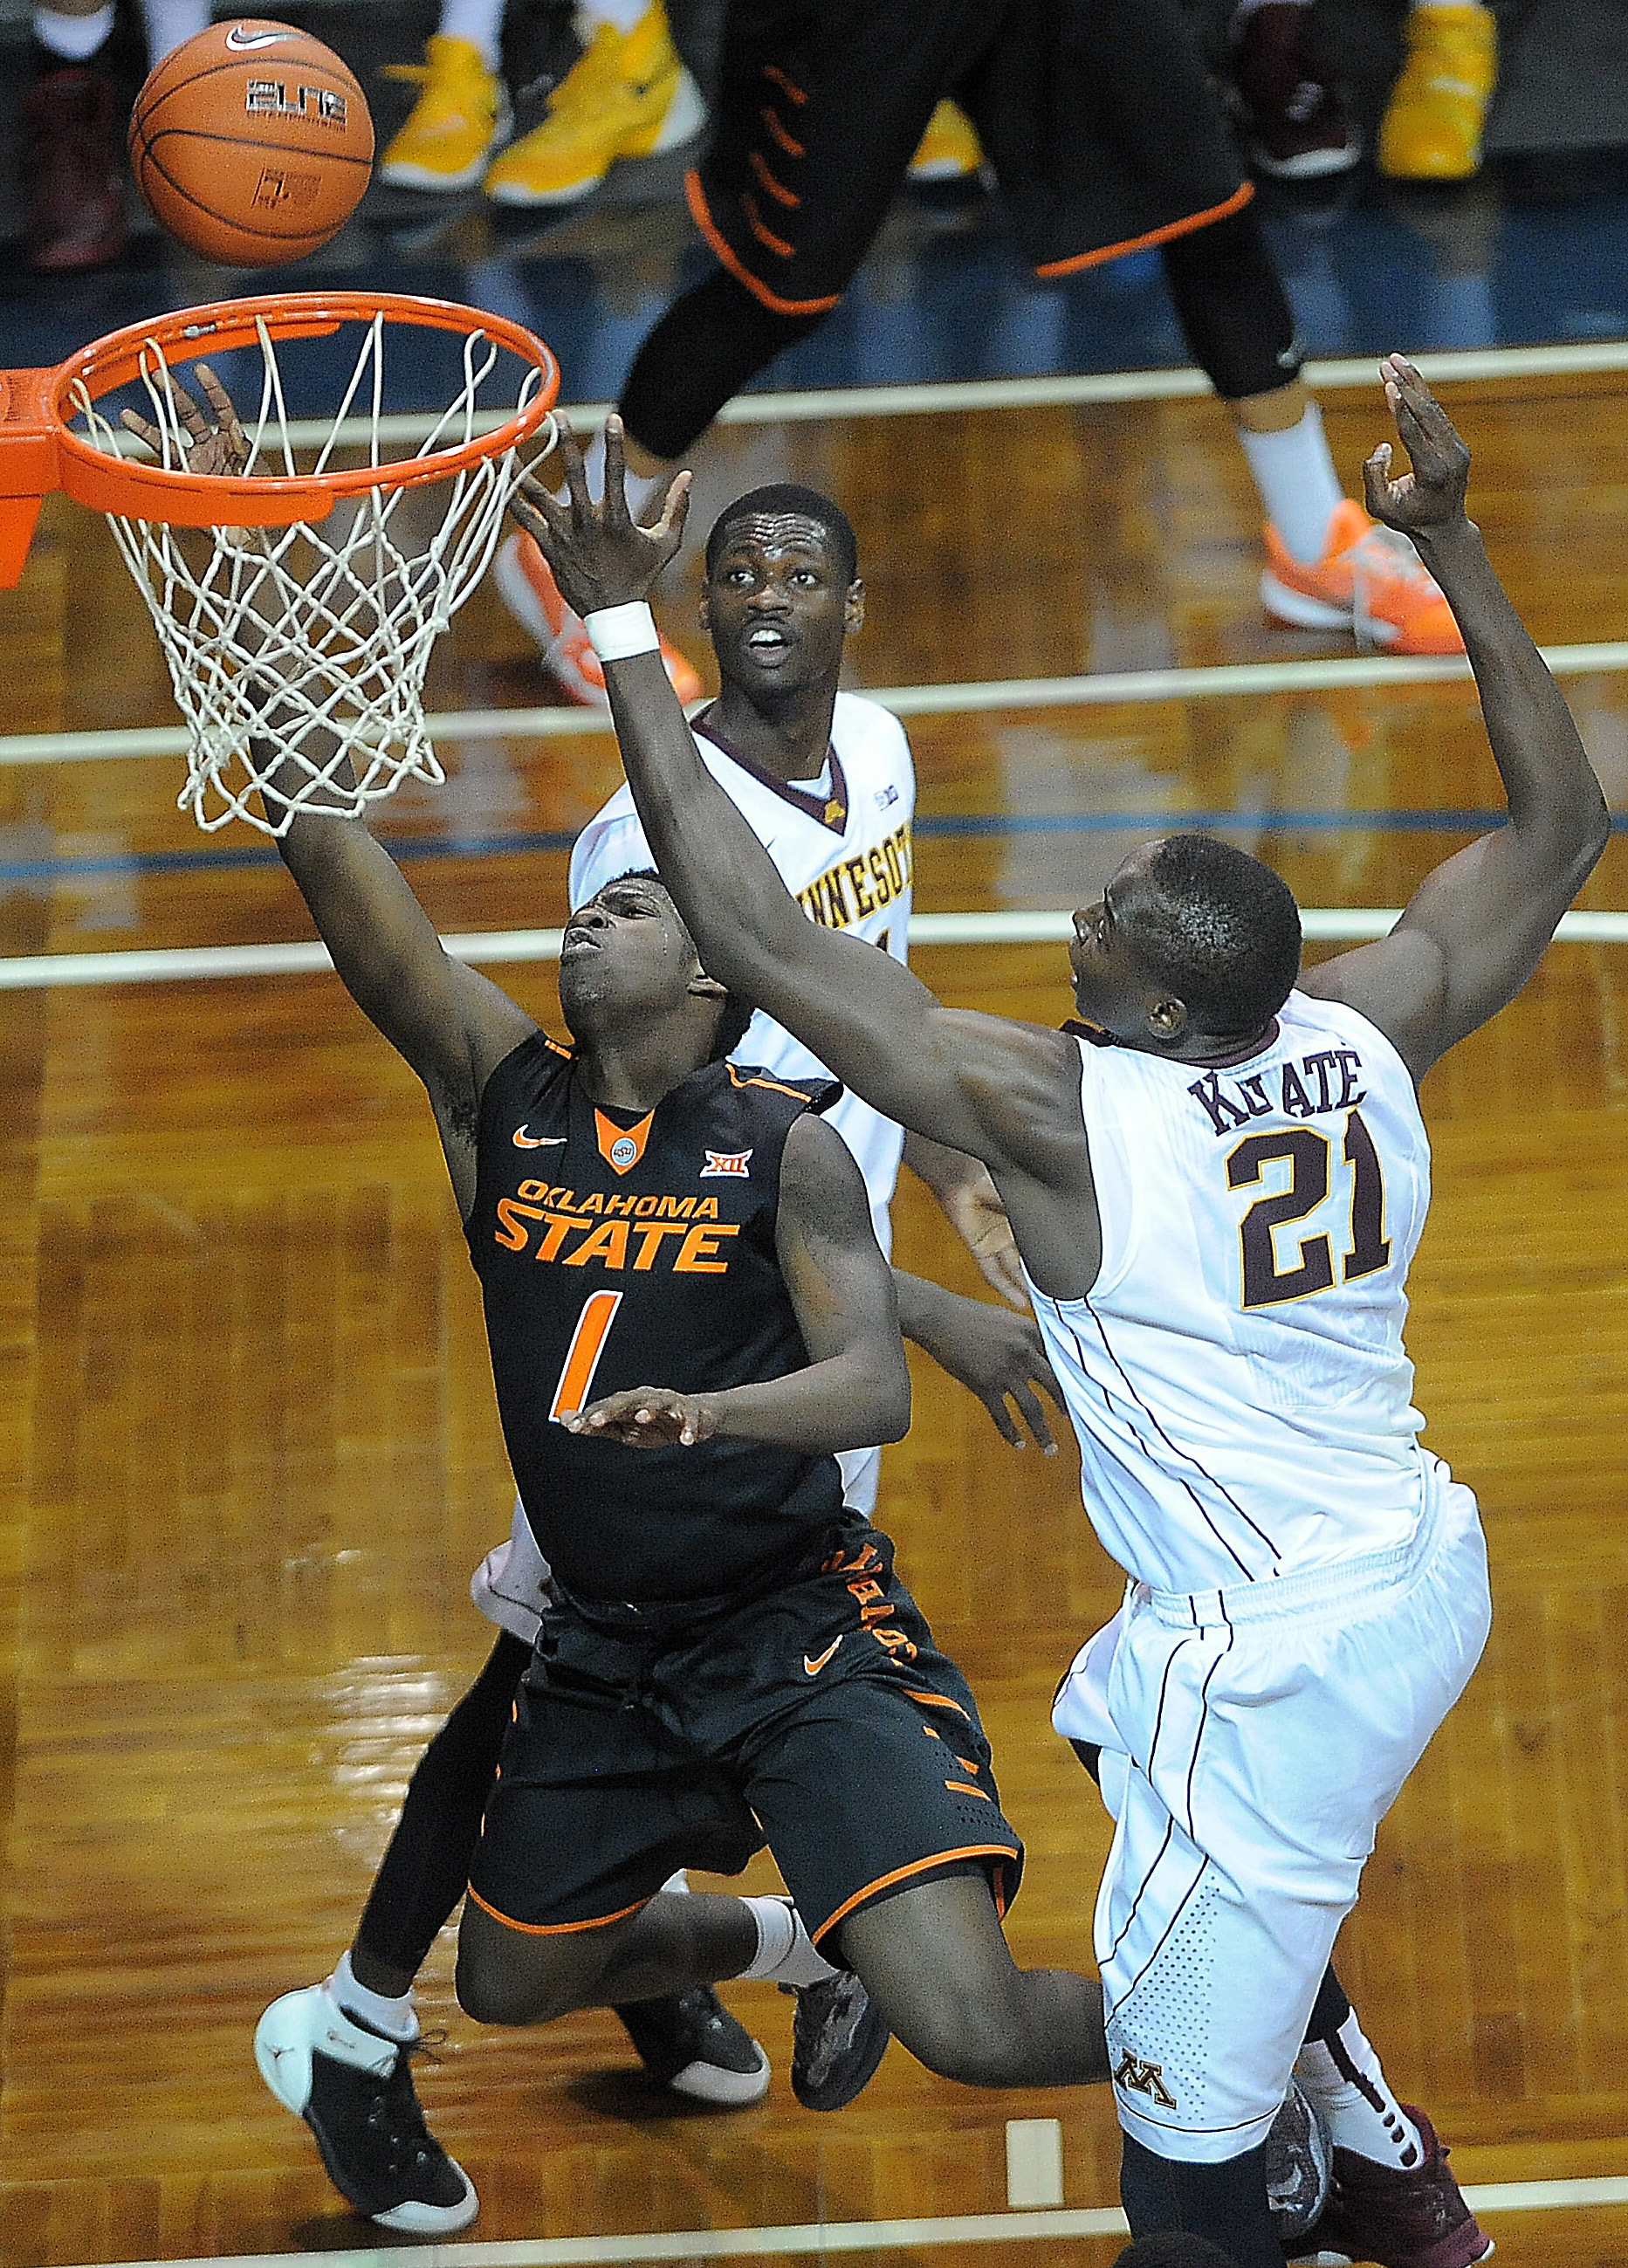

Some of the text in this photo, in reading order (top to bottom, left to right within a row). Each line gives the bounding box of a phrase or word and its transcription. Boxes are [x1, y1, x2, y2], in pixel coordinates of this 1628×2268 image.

[494, 1198, 741, 1274] STATE
[517, 1179, 720, 1220] OKLAHOMA
[1224, 1106, 1393, 1310] 21
[548, 1289, 624, 1425] 1
